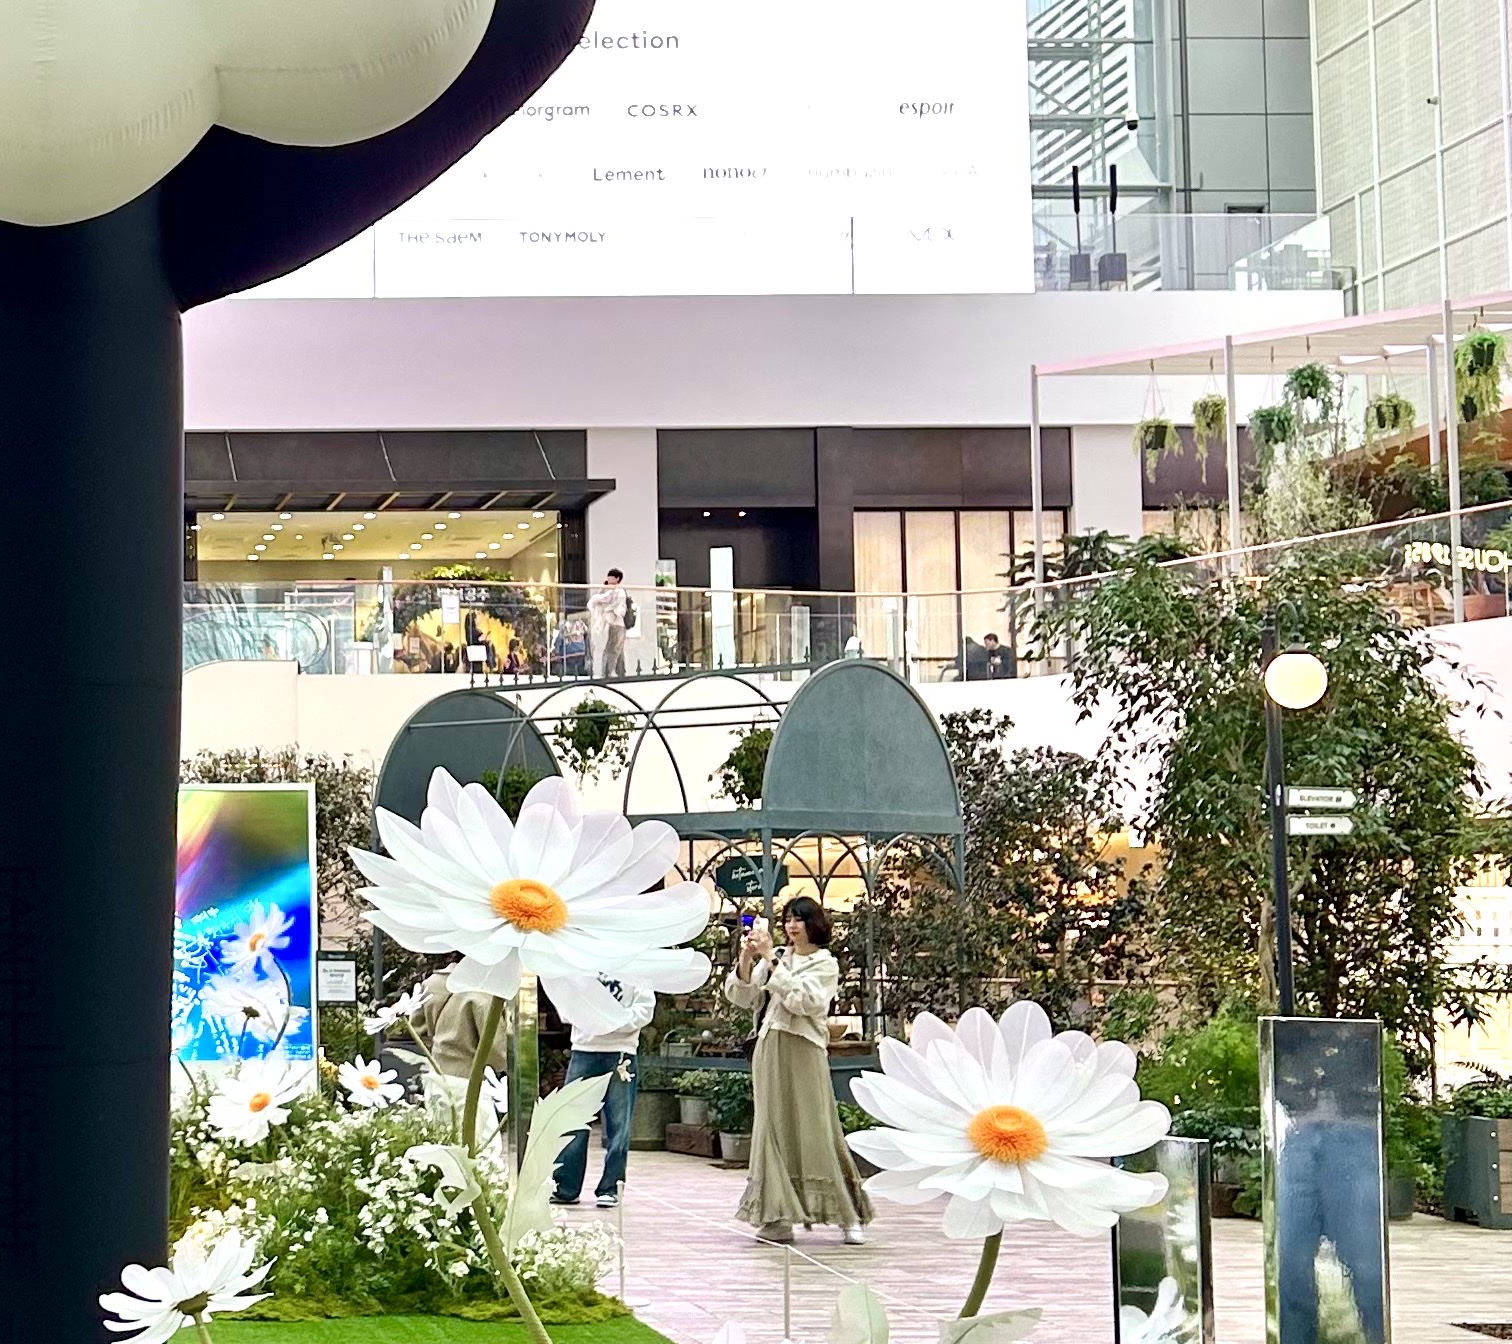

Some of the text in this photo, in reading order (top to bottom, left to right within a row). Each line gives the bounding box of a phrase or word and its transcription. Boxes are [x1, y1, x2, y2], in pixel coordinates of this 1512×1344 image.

[579, 30, 679, 49] election
[628, 104, 698, 117] COSRX
[593, 167, 666, 181] Lement
[519, 231, 607, 243] TONYMOLY
